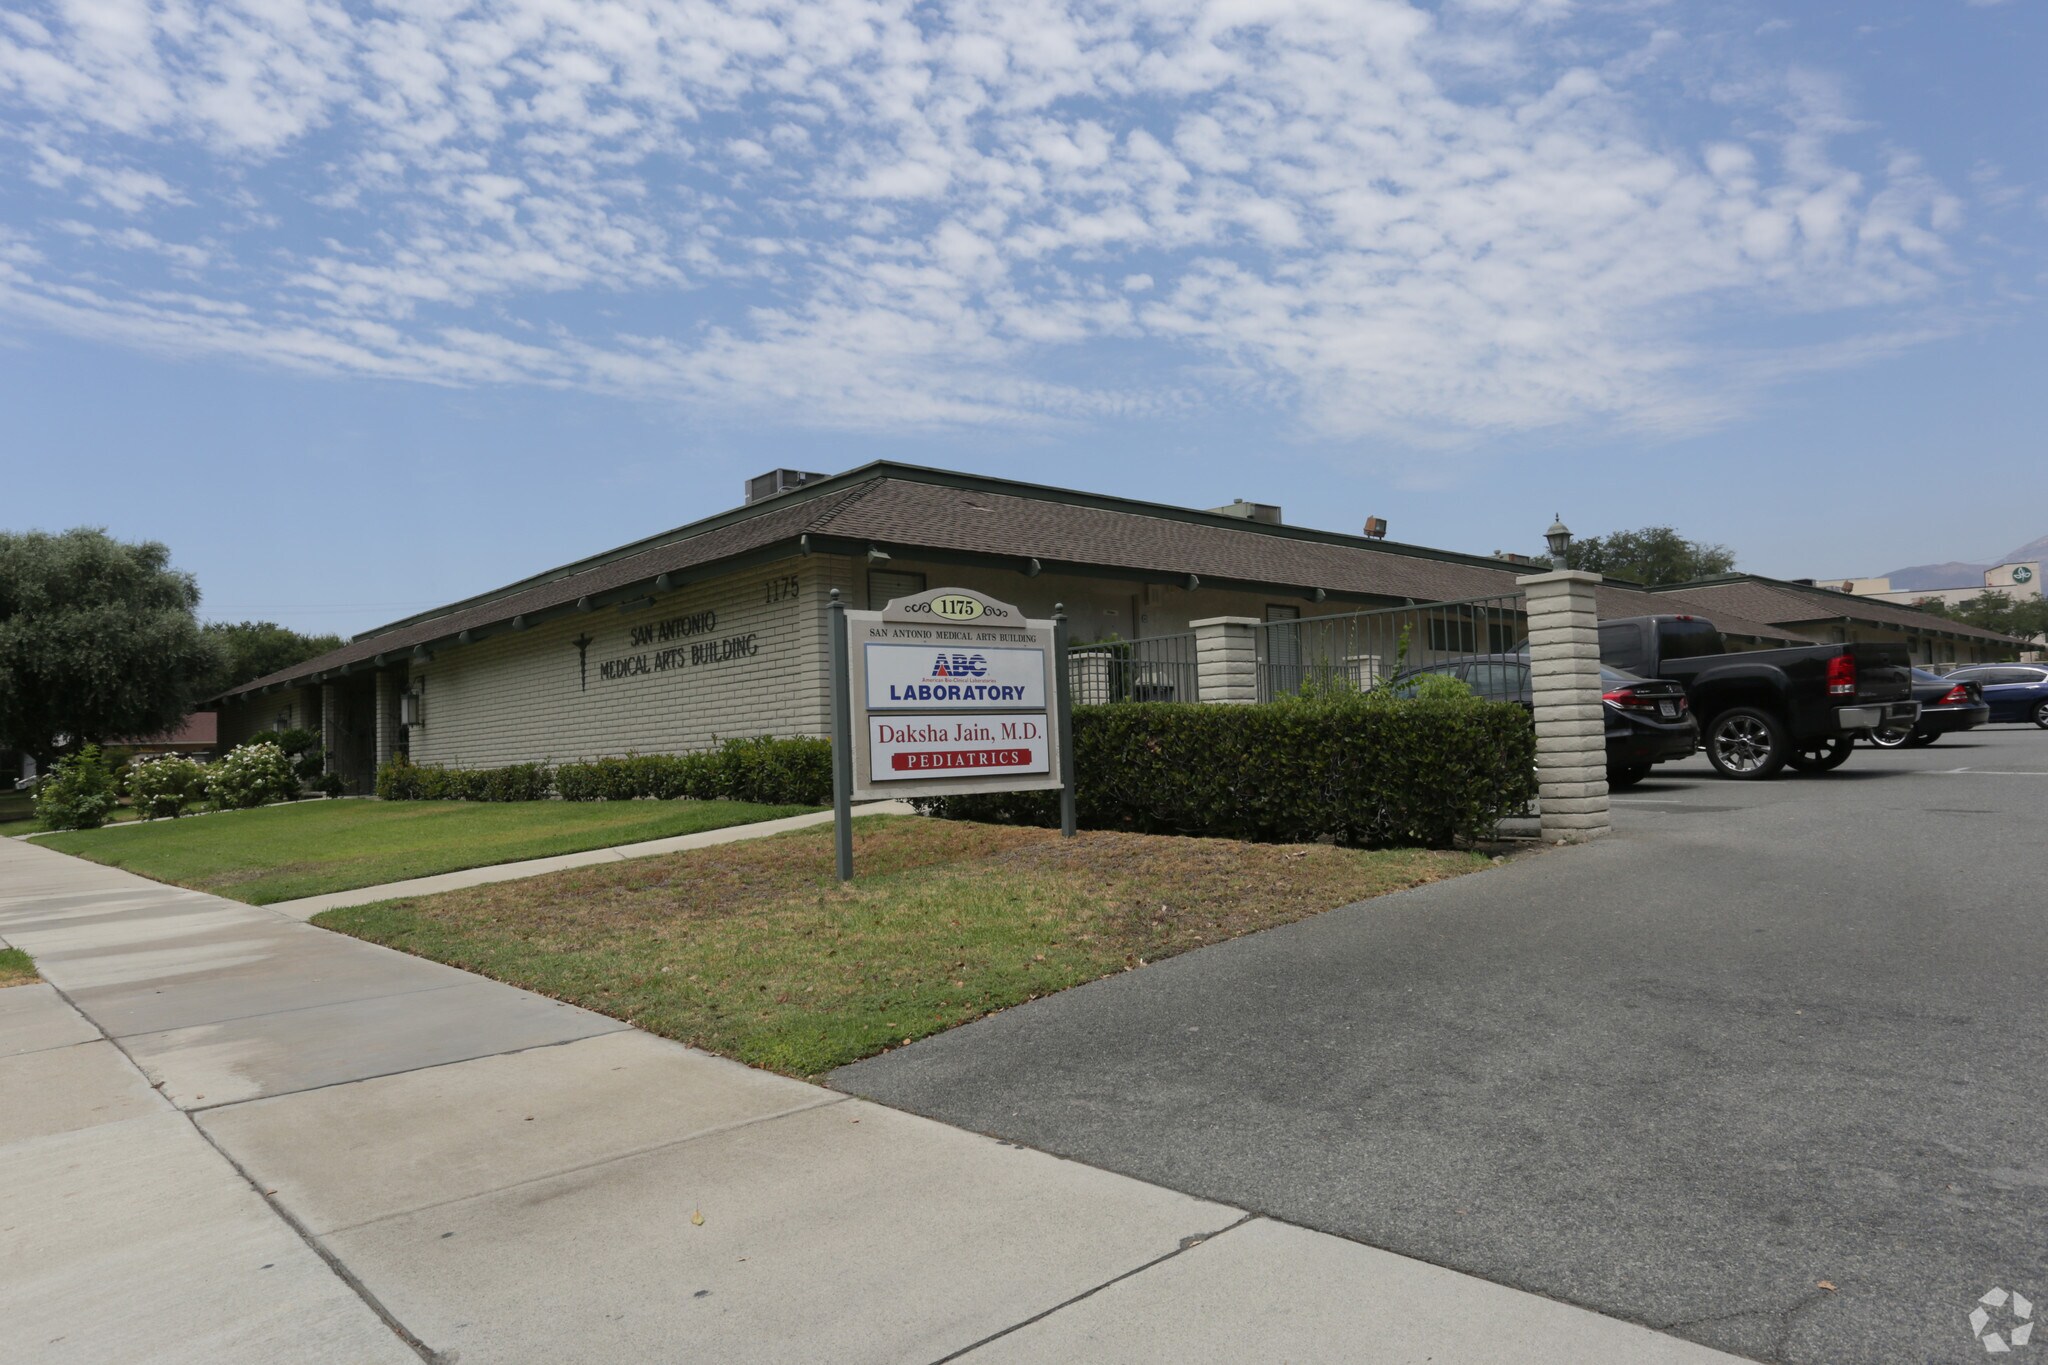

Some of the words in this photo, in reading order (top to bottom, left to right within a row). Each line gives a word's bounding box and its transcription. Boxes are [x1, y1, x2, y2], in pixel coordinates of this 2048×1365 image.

[765, 575, 800, 604] 1175
[940, 599, 974, 616] 1175
[630, 625, 653, 647] SAN
[657, 609, 716, 642] ANTONIO
[869, 628, 888, 637] SAN
[892, 629, 932, 639] ANTONIO
[936, 631, 972, 640] MEDICAL
[976, 633, 997, 641] ARTS
[1000, 634, 1037, 643] BUILDING
[600, 654, 651, 680] MEDICAL
[654, 647, 685, 672] ARTS
[691, 633, 758, 666] BUILDING
[931, 653, 987, 677] ABC
[890, 685, 1025, 701] LABORATORY
[878, 724, 949, 744] Daksha
[954, 723, 996, 743] Jain,
[1001, 722, 1042, 740] M.D.
[907, 751, 1019, 768] PEDIATRICS
